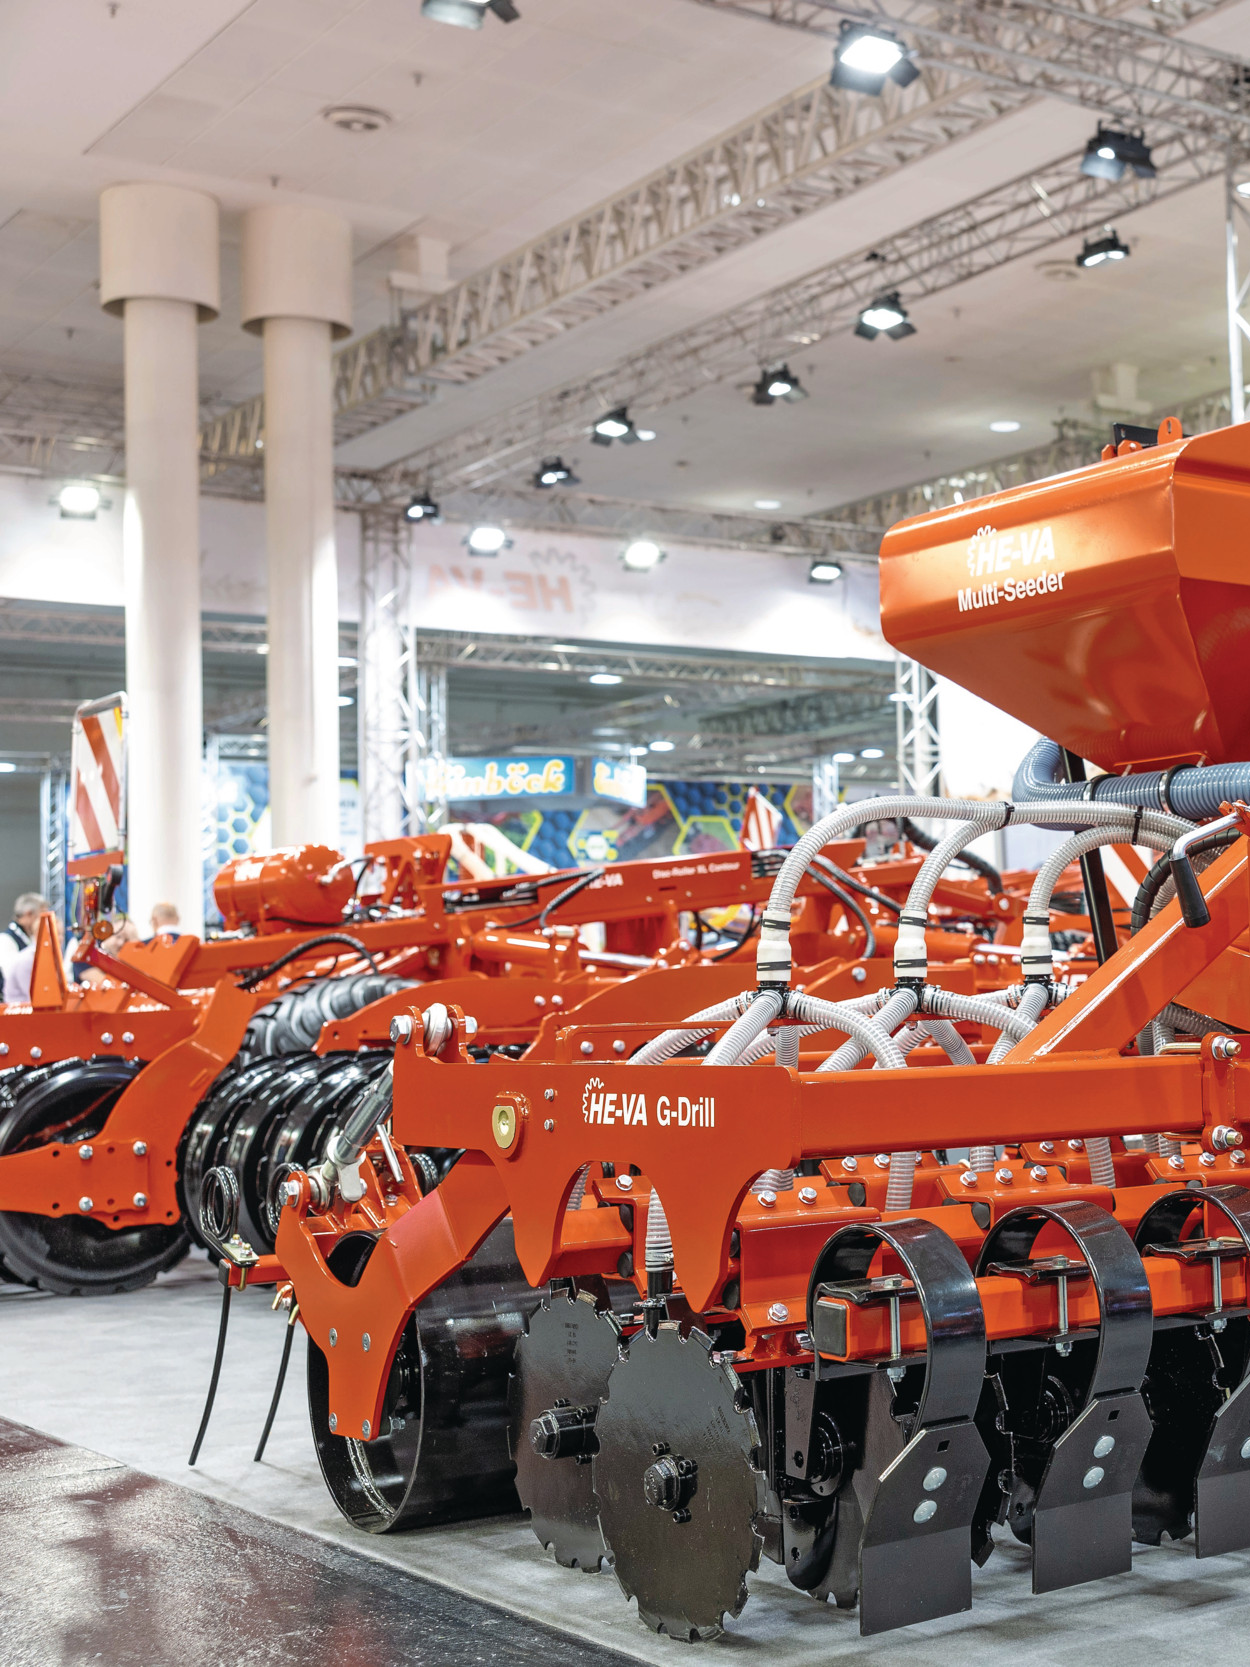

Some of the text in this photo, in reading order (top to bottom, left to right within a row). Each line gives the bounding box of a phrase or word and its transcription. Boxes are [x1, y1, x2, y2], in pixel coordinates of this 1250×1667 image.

[976, 525, 1056, 577] HE-VA
[957, 571, 1066, 613] Multi-Seeder
[588, 1093, 715, 1127] HE-VA G-Drill
